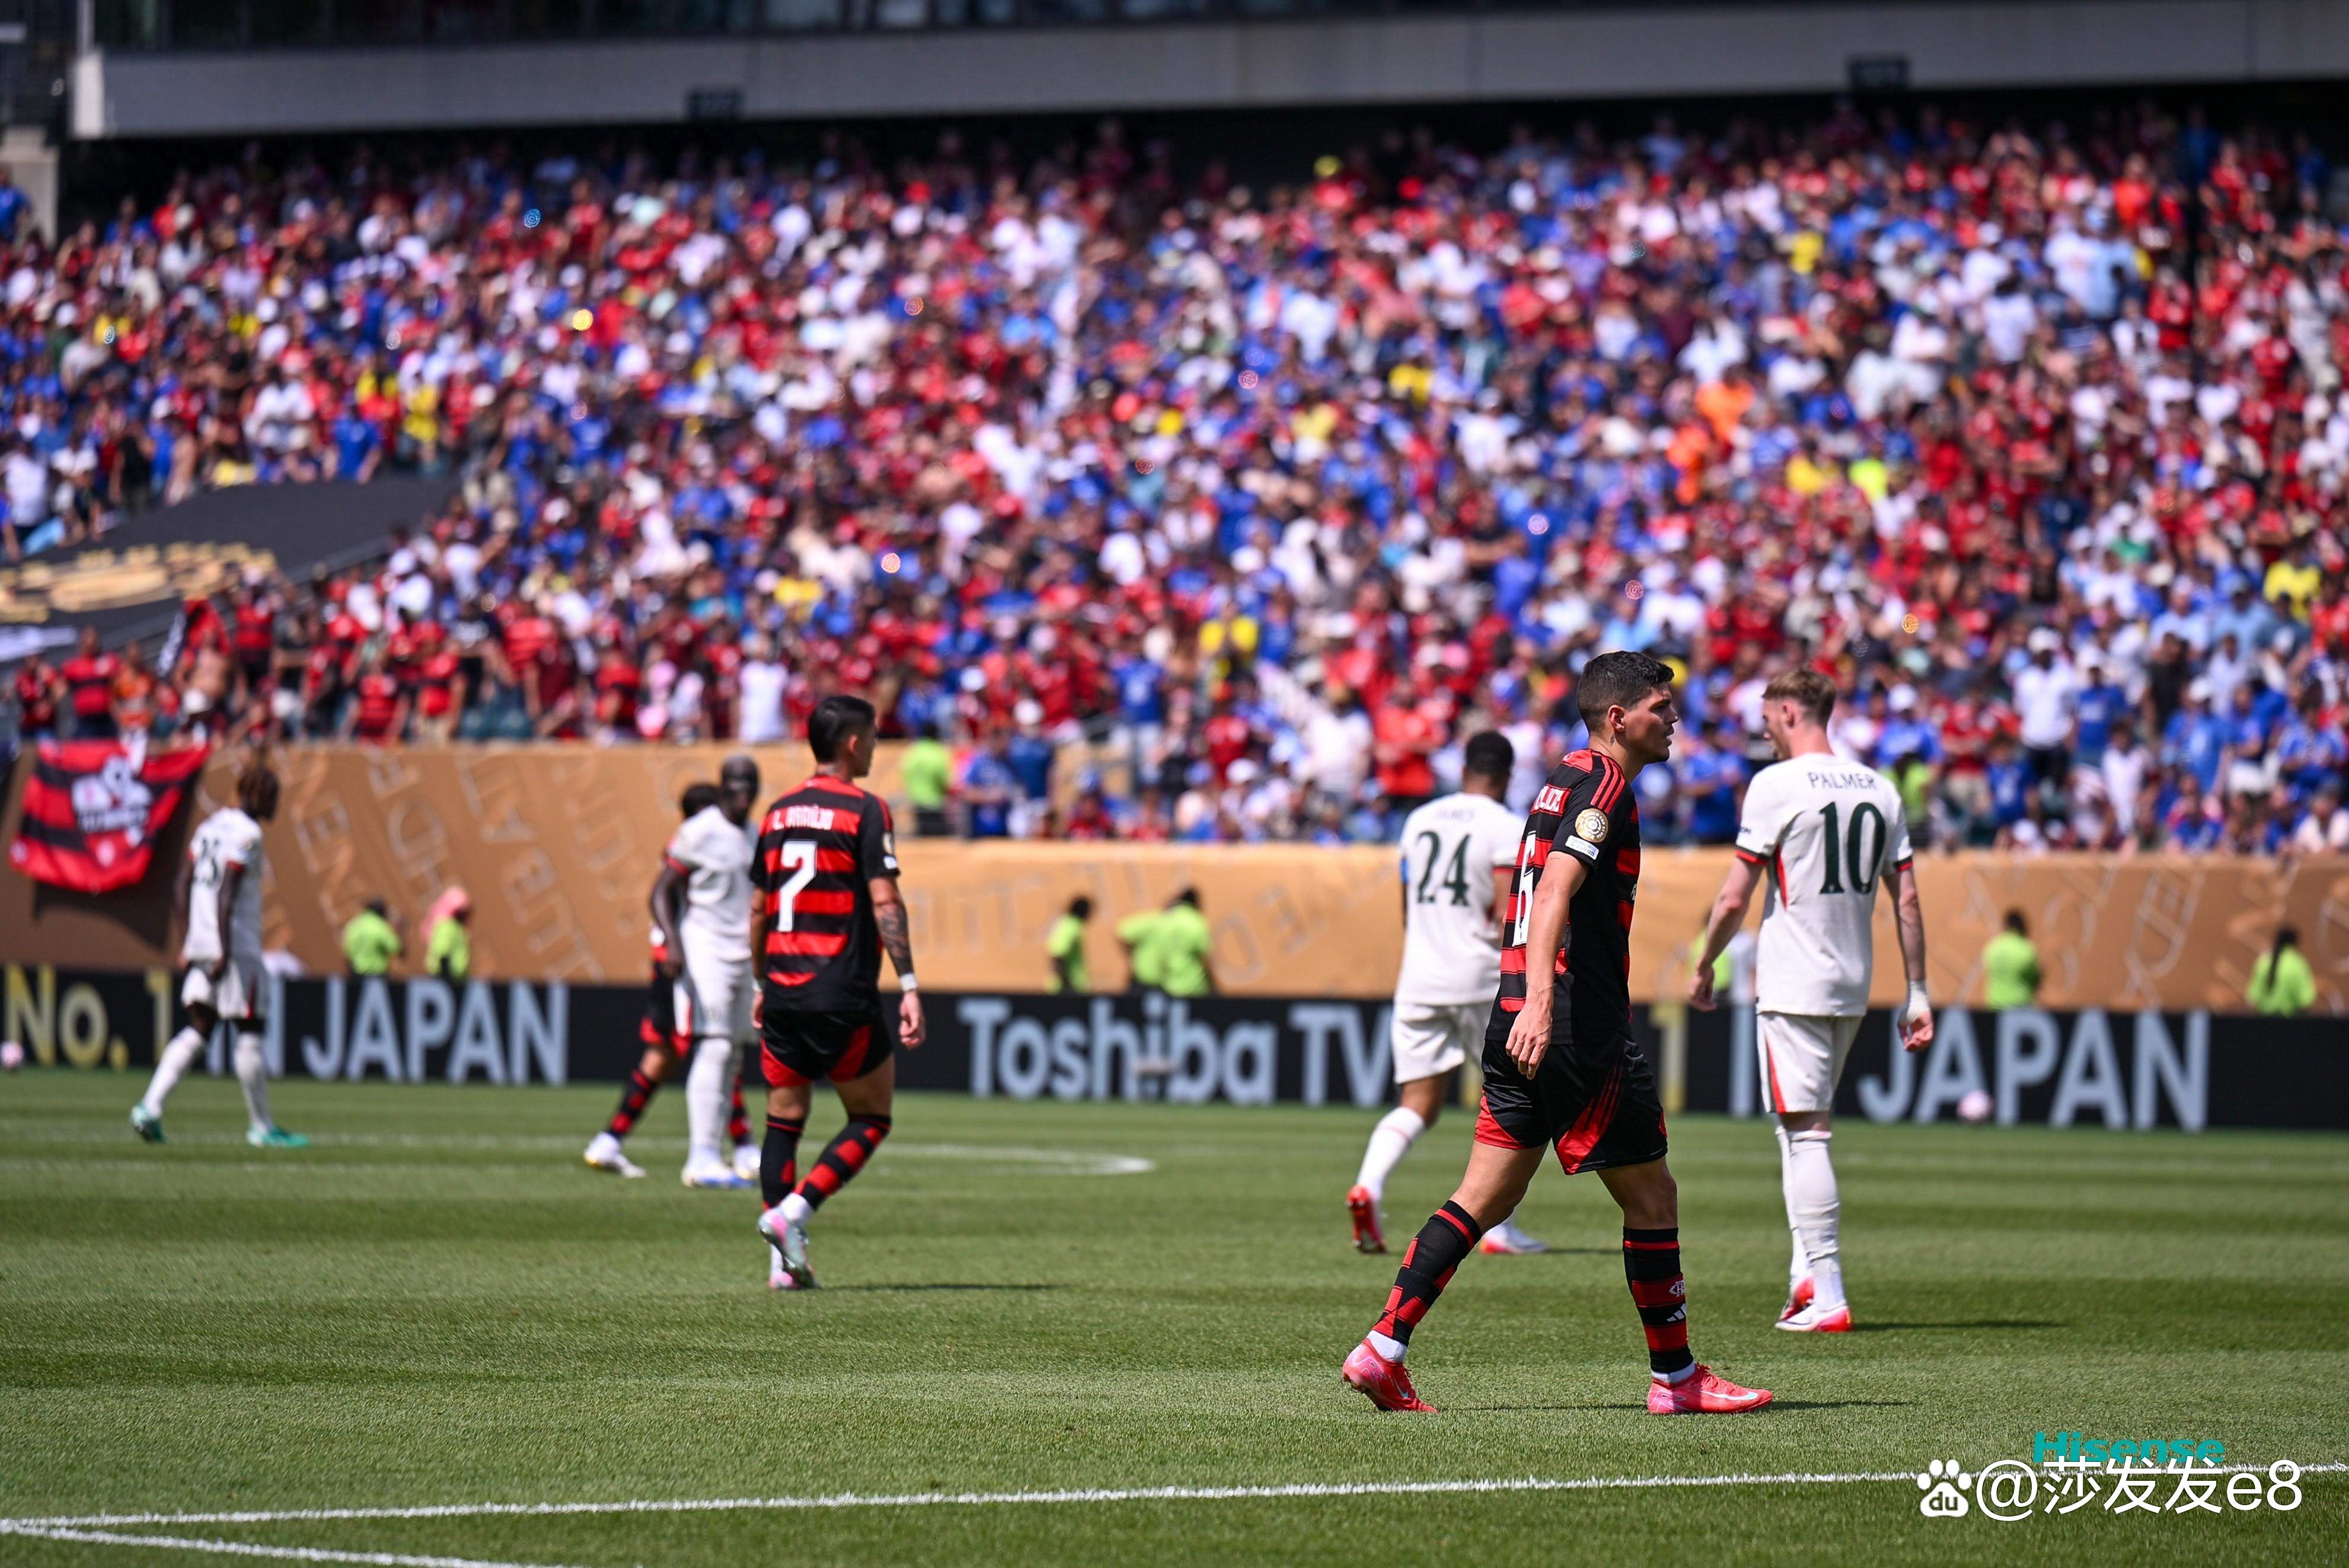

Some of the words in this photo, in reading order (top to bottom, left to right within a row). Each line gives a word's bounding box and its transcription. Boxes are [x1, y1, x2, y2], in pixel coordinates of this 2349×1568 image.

[1808, 772, 1877, 790] PALMER
[777, 839, 818, 932] 7
[1415, 829, 1472, 906] 24
[1819, 801, 1886, 895] 10
[5, 962, 129, 1069] No.
[301, 978, 569, 1086] JAPAN
[956, 991, 1277, 1106] Toshiba
[1287, 1002, 1394, 1110] TV
[1858, 1008, 2210, 1132] JAPAN
